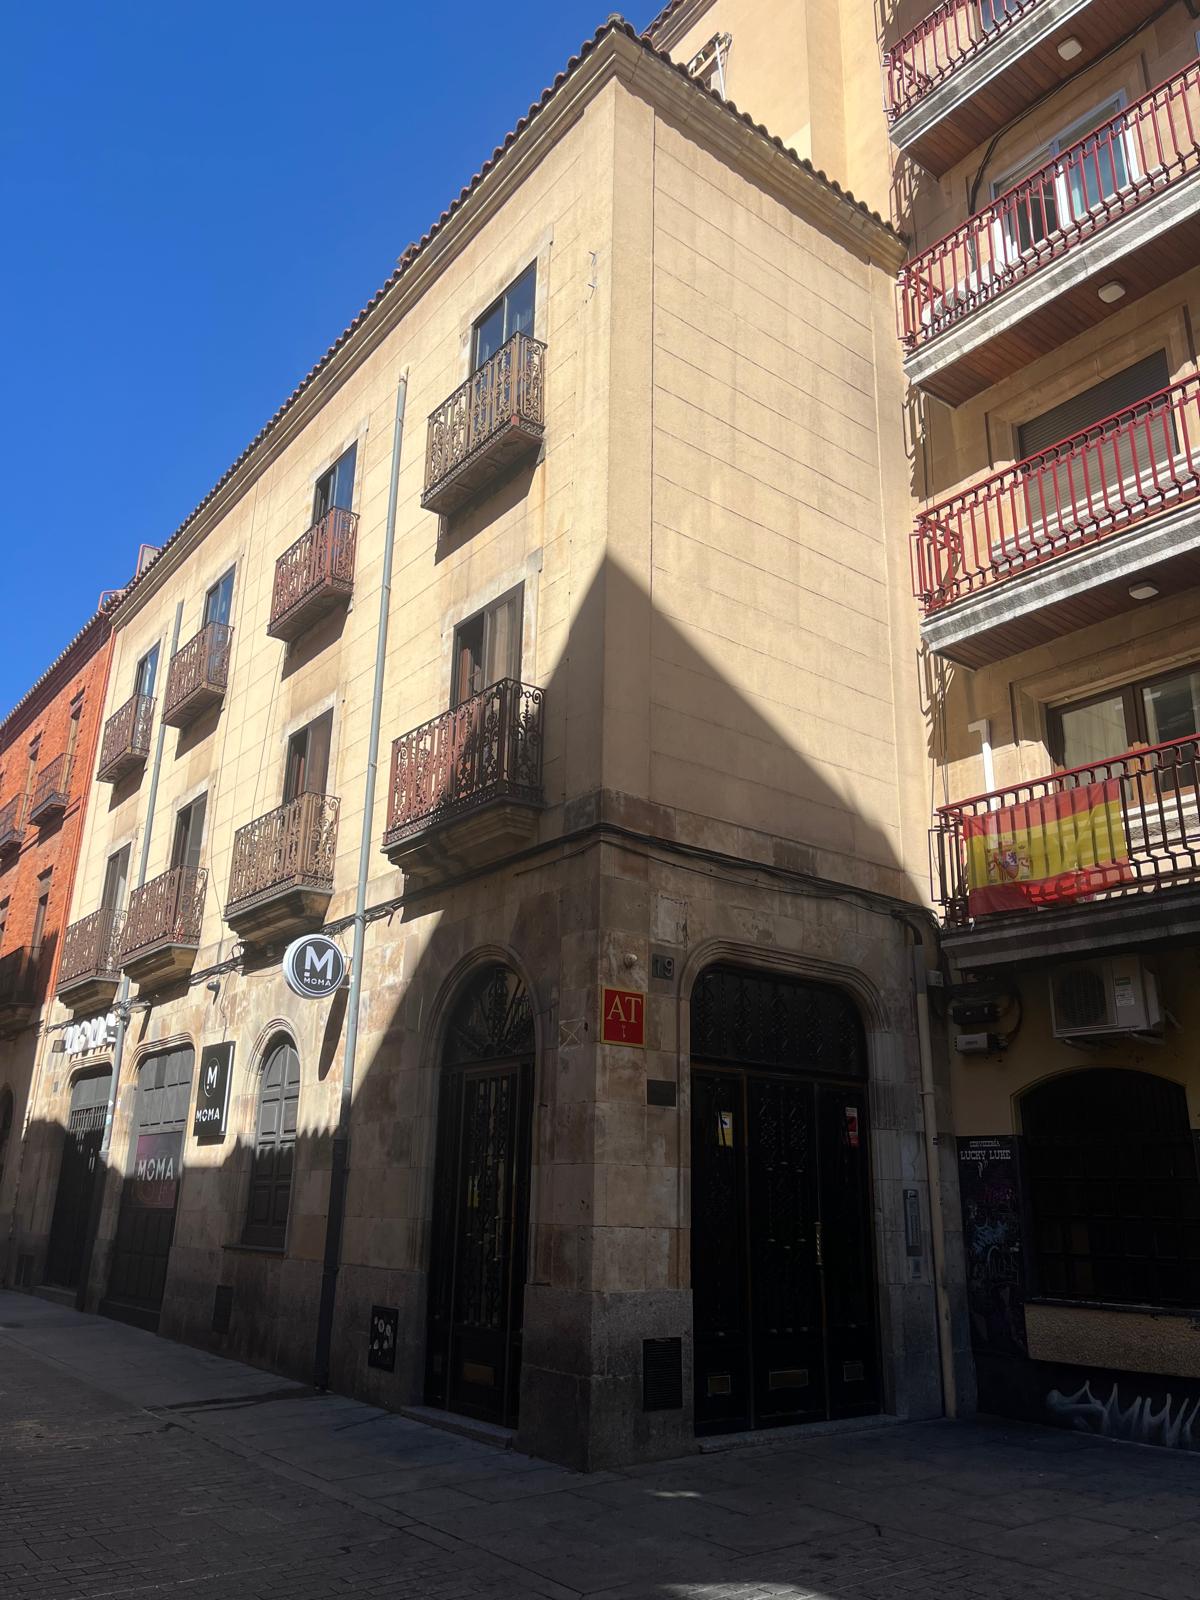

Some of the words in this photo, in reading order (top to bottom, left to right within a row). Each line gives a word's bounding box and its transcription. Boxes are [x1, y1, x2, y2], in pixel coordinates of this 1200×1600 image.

[303, 977, 331, 987] MOMA
[606, 994, 641, 1023] AT
[196, 1107, 220, 1122] MOMA
[960, 1150, 985, 1160] LUCKY
[989, 1149, 1011, 1160] LUKE
[137, 1157, 174, 1181] MOMA
